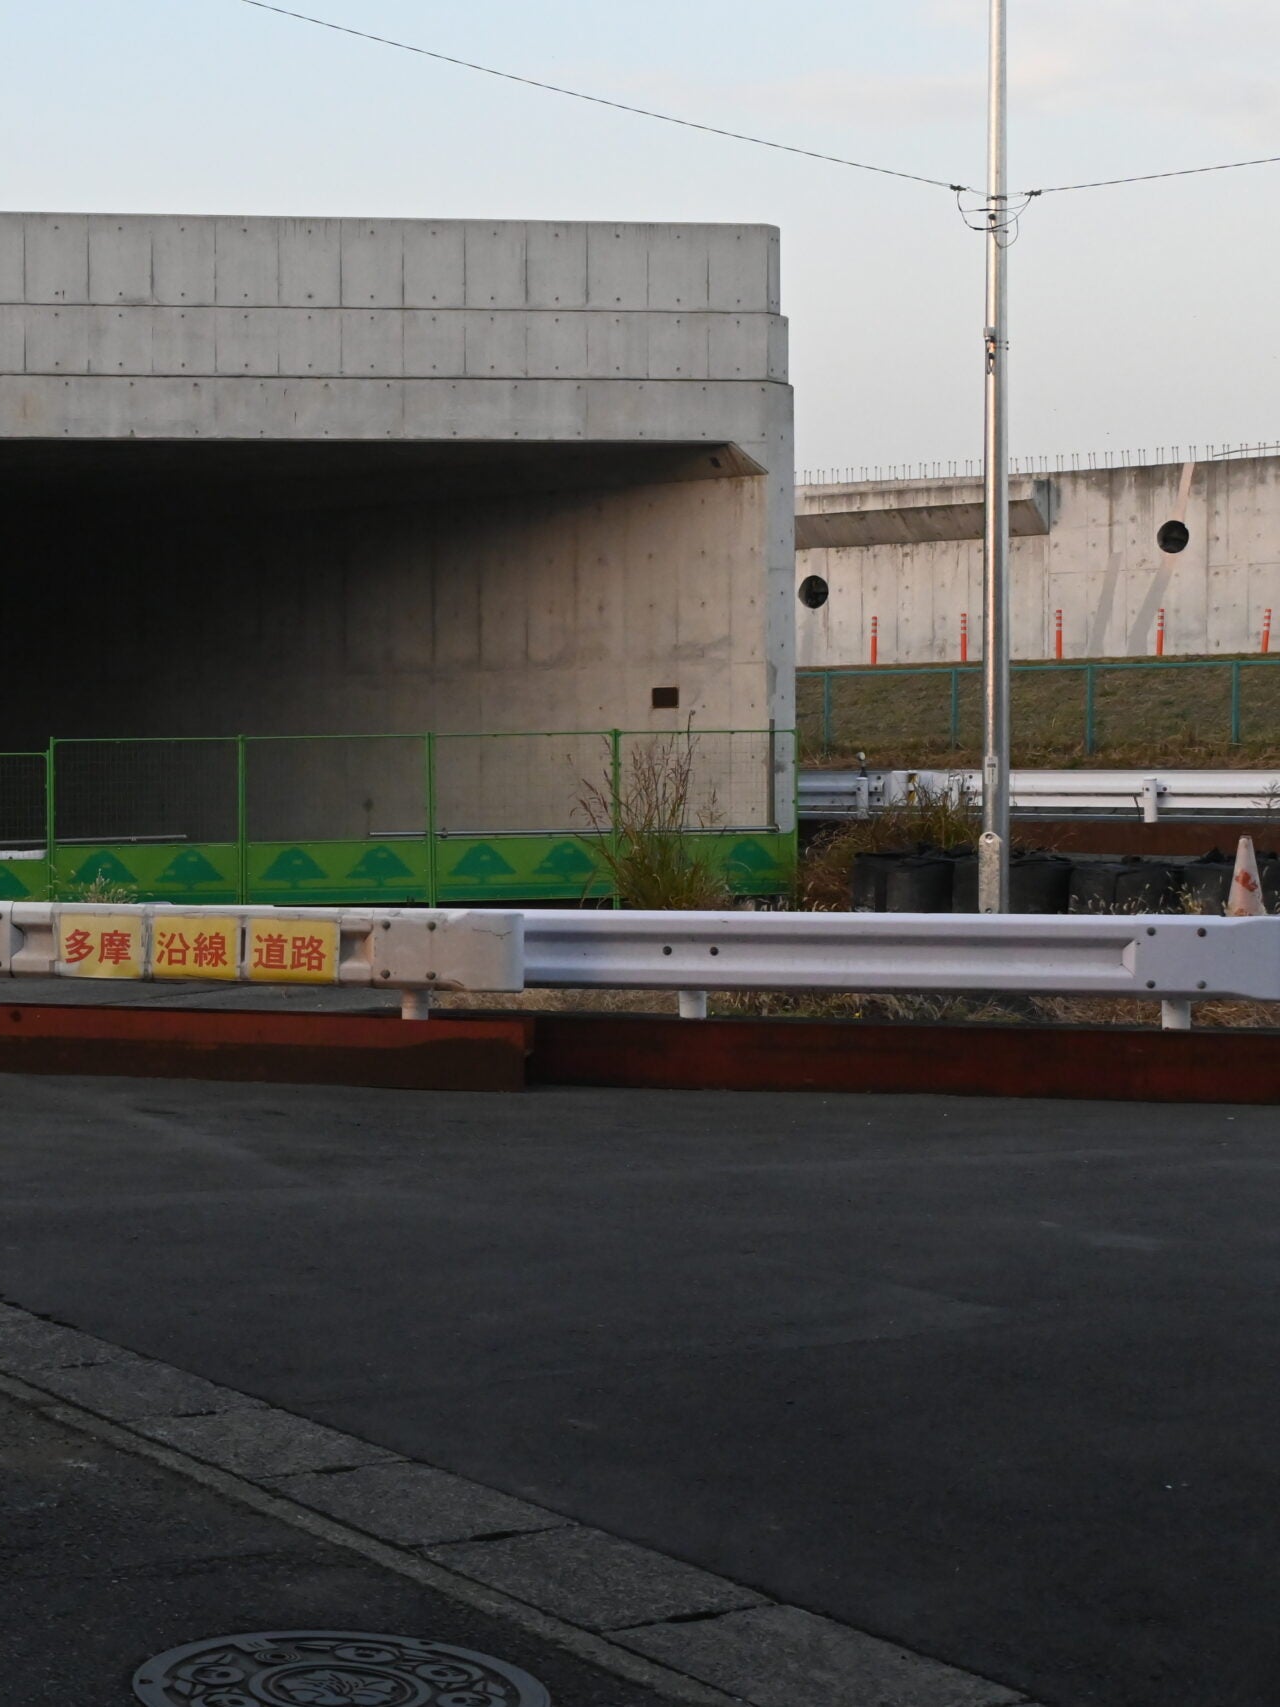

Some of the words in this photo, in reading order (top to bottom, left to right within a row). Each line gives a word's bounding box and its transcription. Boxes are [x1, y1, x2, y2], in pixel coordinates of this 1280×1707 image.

[64, 929, 132, 965] 多摩
[156, 931, 228, 968] 沿線
[253, 933, 327, 972] 道路
